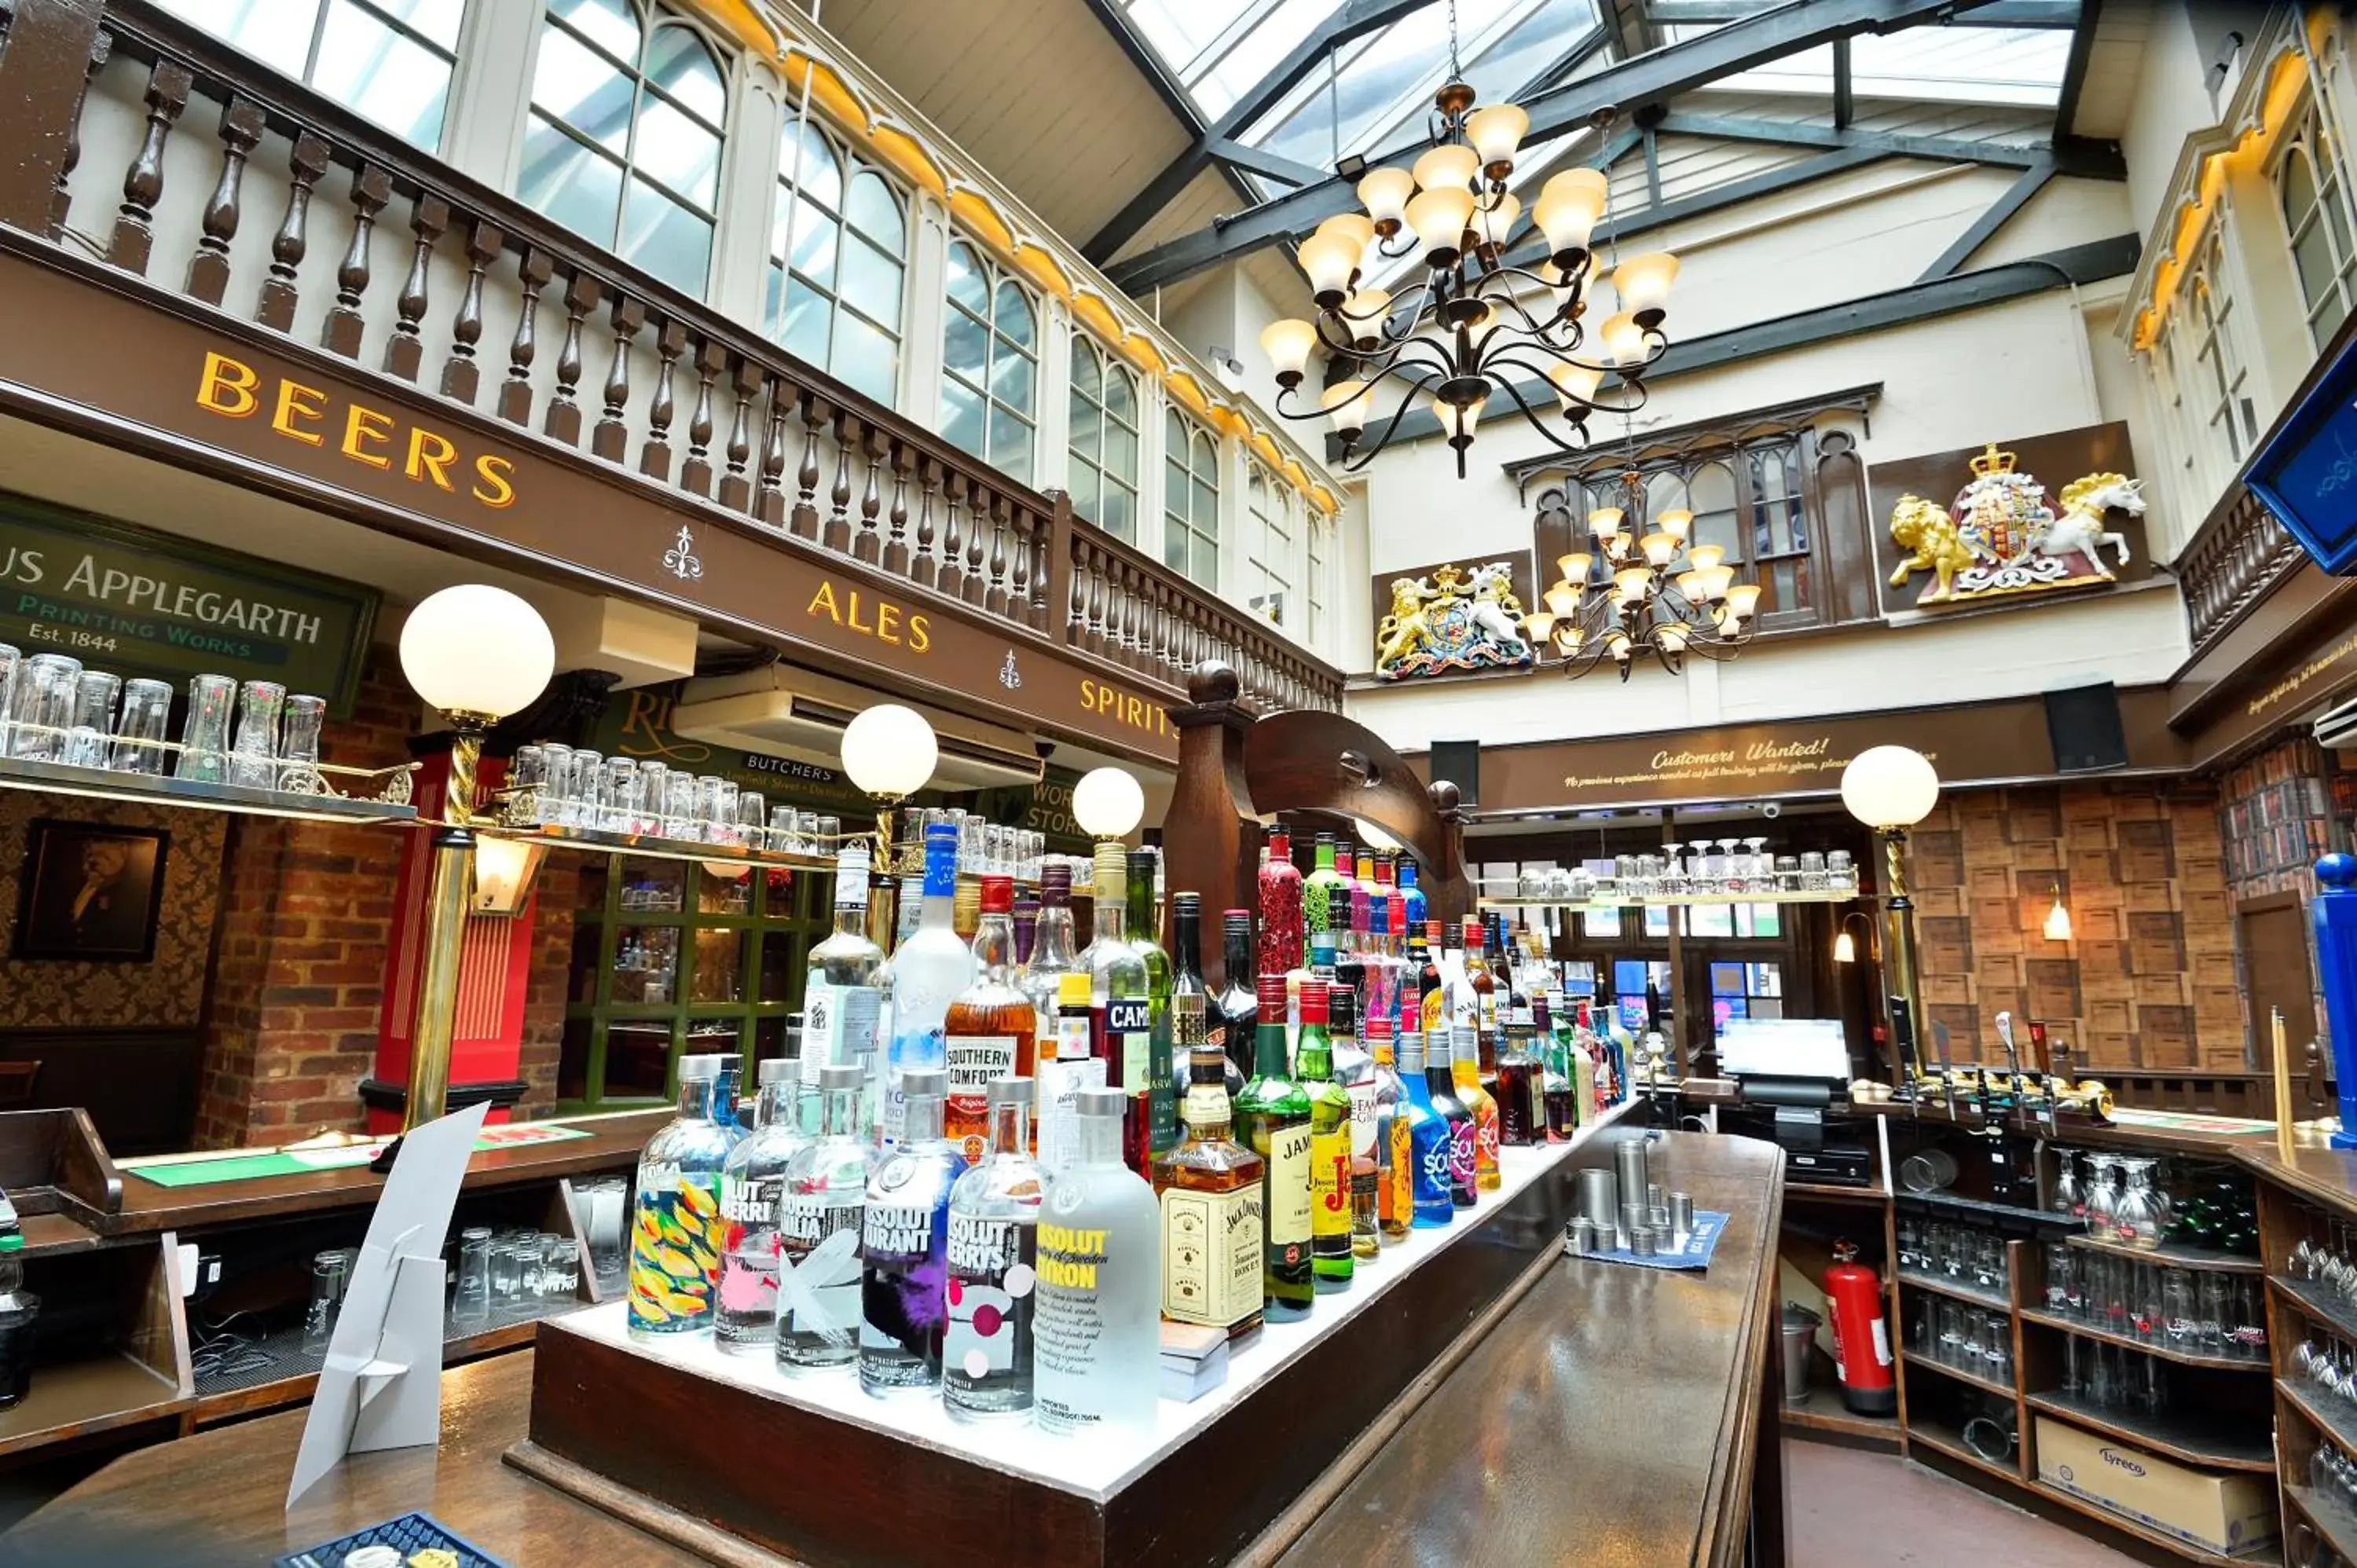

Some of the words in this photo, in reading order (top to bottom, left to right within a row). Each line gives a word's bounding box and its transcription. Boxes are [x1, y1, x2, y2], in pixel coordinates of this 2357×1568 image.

[196, 351, 516, 509] BEERS
[64, 555, 321, 644] APPLEGARTH
[16, 595, 156, 639] PRINTING
[167, 625, 251, 658] WORKS
[807, 581, 930, 654] ALES
[28, 623, 64, 644] Est.
[70, 632, 117, 652] 1844
[748, 755, 831, 781] BUTCHERS
[1651, 749, 1733, 770] Customers
[1746, 738, 1830, 762] Wanted!
[1614, 772, 1658, 786] experience
[1032, 784, 1073, 808] WOR
[948, 1049, 1011, 1066] SOUTHERN
[948, 1219, 1006, 1245] SOLUT
[948, 1237, 1004, 1270] ERRYS
[2104, 1451, 2142, 1473] Lyreco
